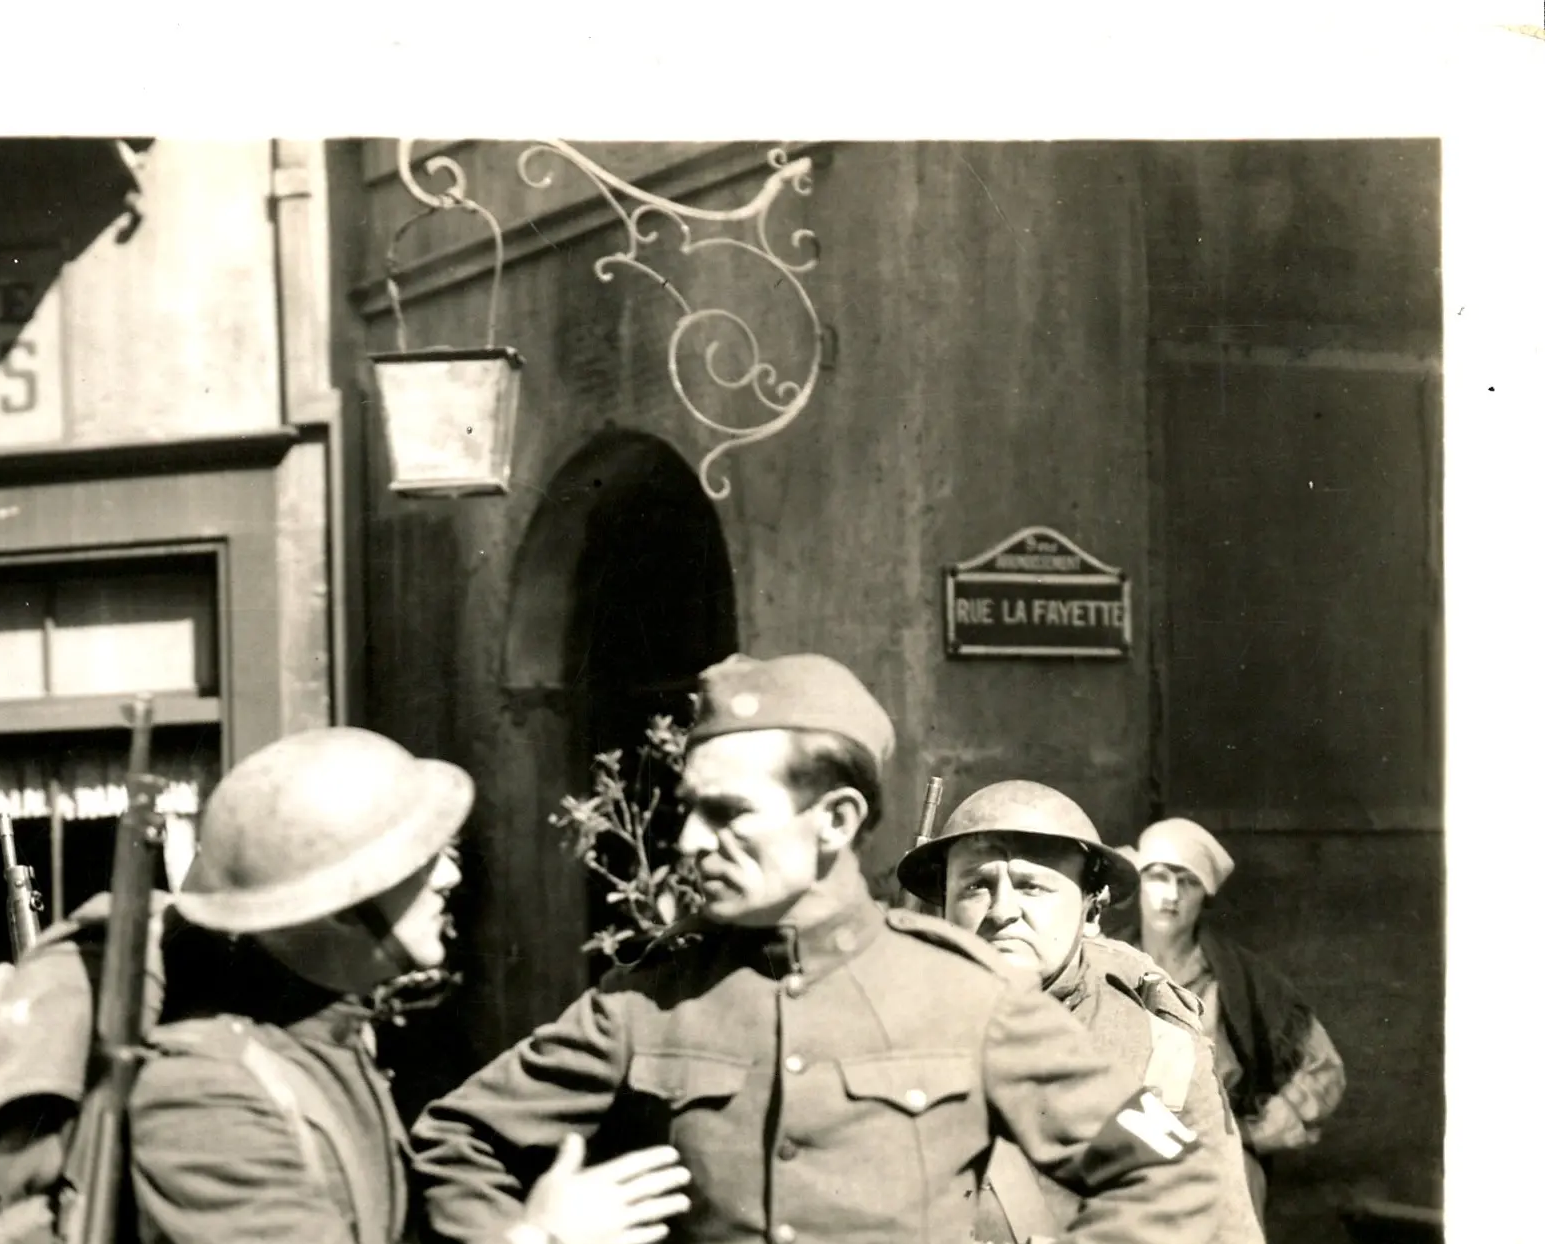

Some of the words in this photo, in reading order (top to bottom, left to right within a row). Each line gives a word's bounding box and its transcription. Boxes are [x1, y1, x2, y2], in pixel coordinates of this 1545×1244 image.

[956, 598, 995, 625] RUE
[1002, 599, 1028, 625] LA
[1032, 599, 1124, 627] FAYETTE
